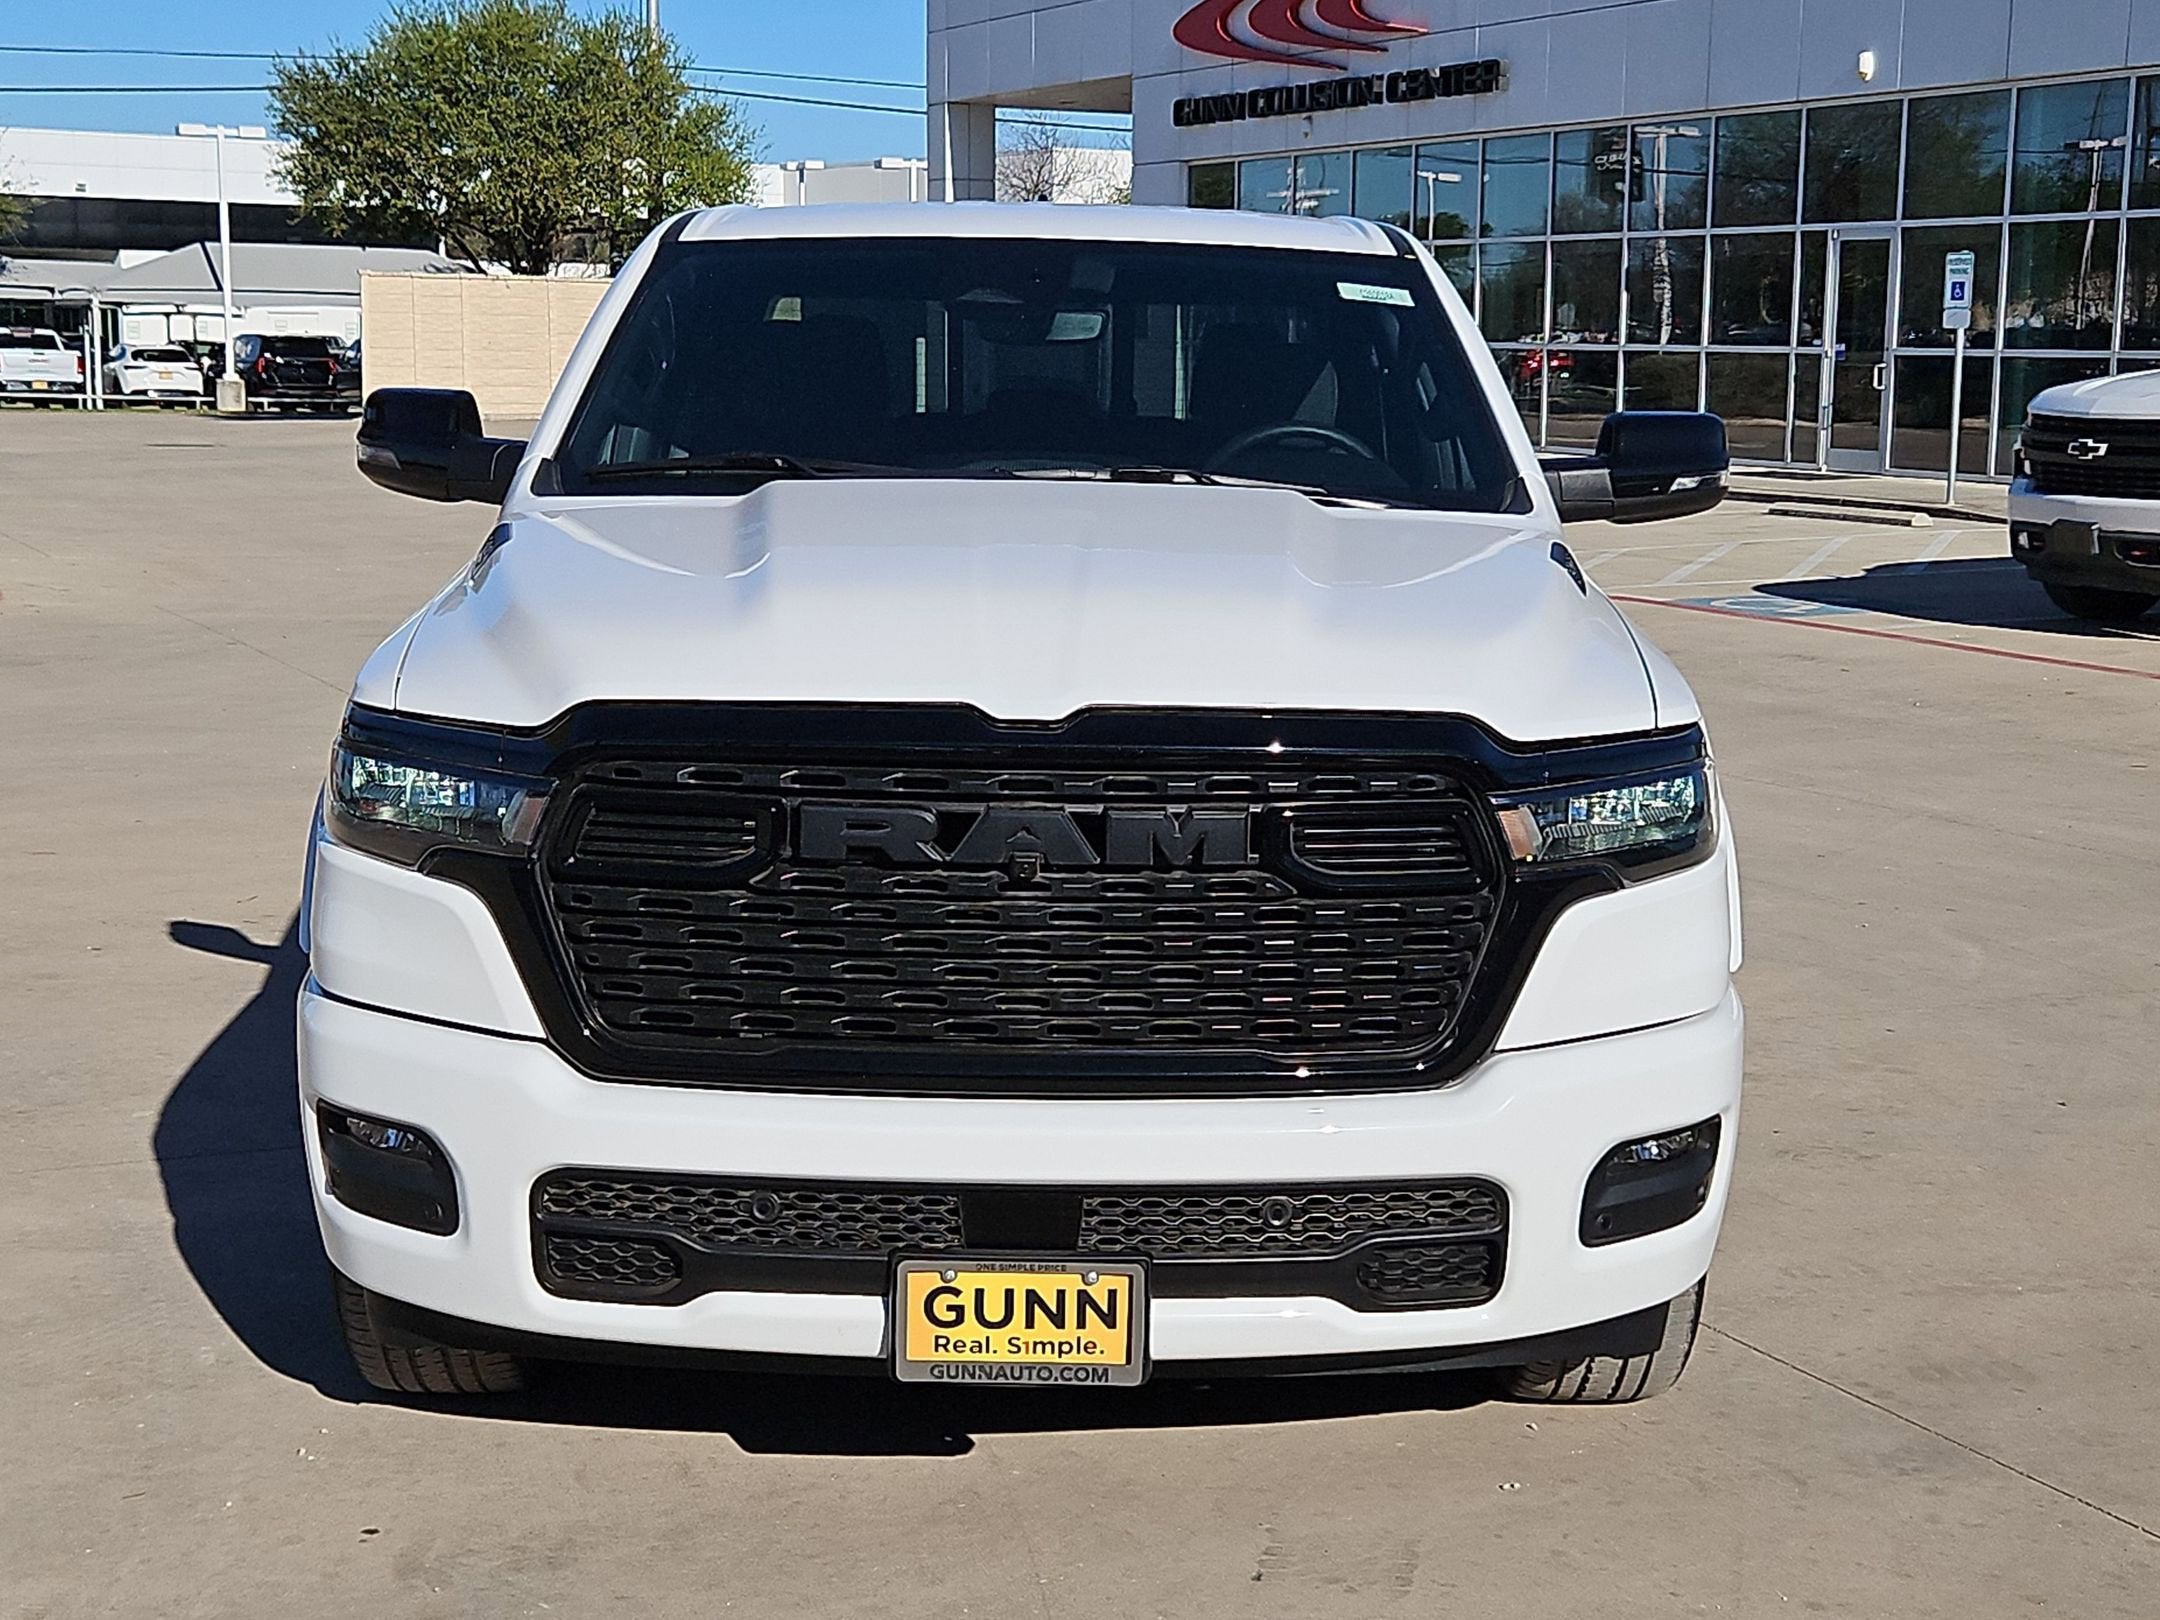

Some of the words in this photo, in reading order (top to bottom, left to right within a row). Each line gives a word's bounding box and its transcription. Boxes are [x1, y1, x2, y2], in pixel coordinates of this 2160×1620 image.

[1174, 93, 1247, 127] GUNN
[1248, 74, 1384, 118] COLLISION
[1386, 59, 1509, 103] CENTER
[799, 803, 1251, 864] RAM
[975, 1263, 997, 1271] ONE
[998, 1263, 1036, 1272] SIMPLE
[1037, 1264, 1068, 1272] PRICE
[923, 1285, 1118, 1330] GUNN
[934, 1334, 998, 1354] Real.
[929, 1364, 1110, 1383] GUNNAUTO.COM
